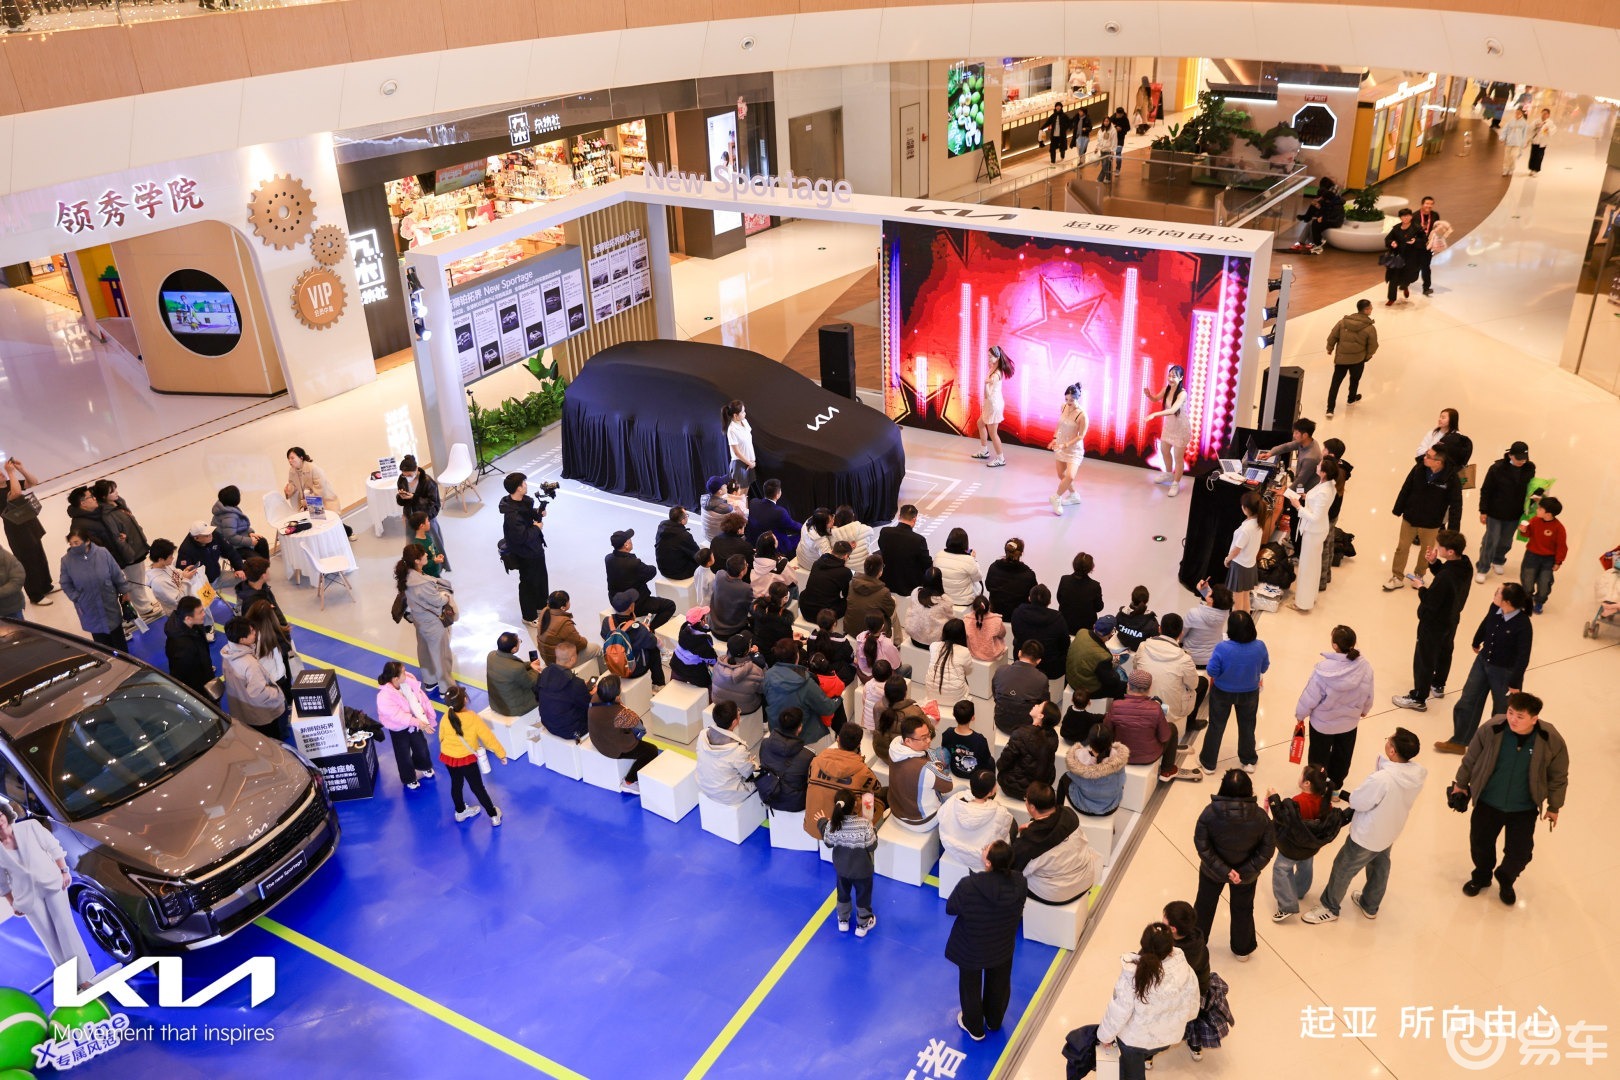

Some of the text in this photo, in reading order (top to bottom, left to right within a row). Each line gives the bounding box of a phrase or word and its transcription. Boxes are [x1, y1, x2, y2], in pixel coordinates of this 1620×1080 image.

[643, 161, 853, 209] New Sportage
[56, 177, 204, 234] 领秀学院
[904, 205, 1018, 221] KIA
[1063, 219, 1244, 244] 起亚 所向由心
[306, 281, 333, 309] VIP
[483, 285, 500, 296] New
[501, 270, 533, 288] Sportage
[806, 406, 840, 431] KIA
[1118, 624, 1143, 638] CHINA
[265, 880, 275, 890] The
[40, 1015, 126, 1064] X-Line
[56, 1037, 118, 1066] 专属风范
